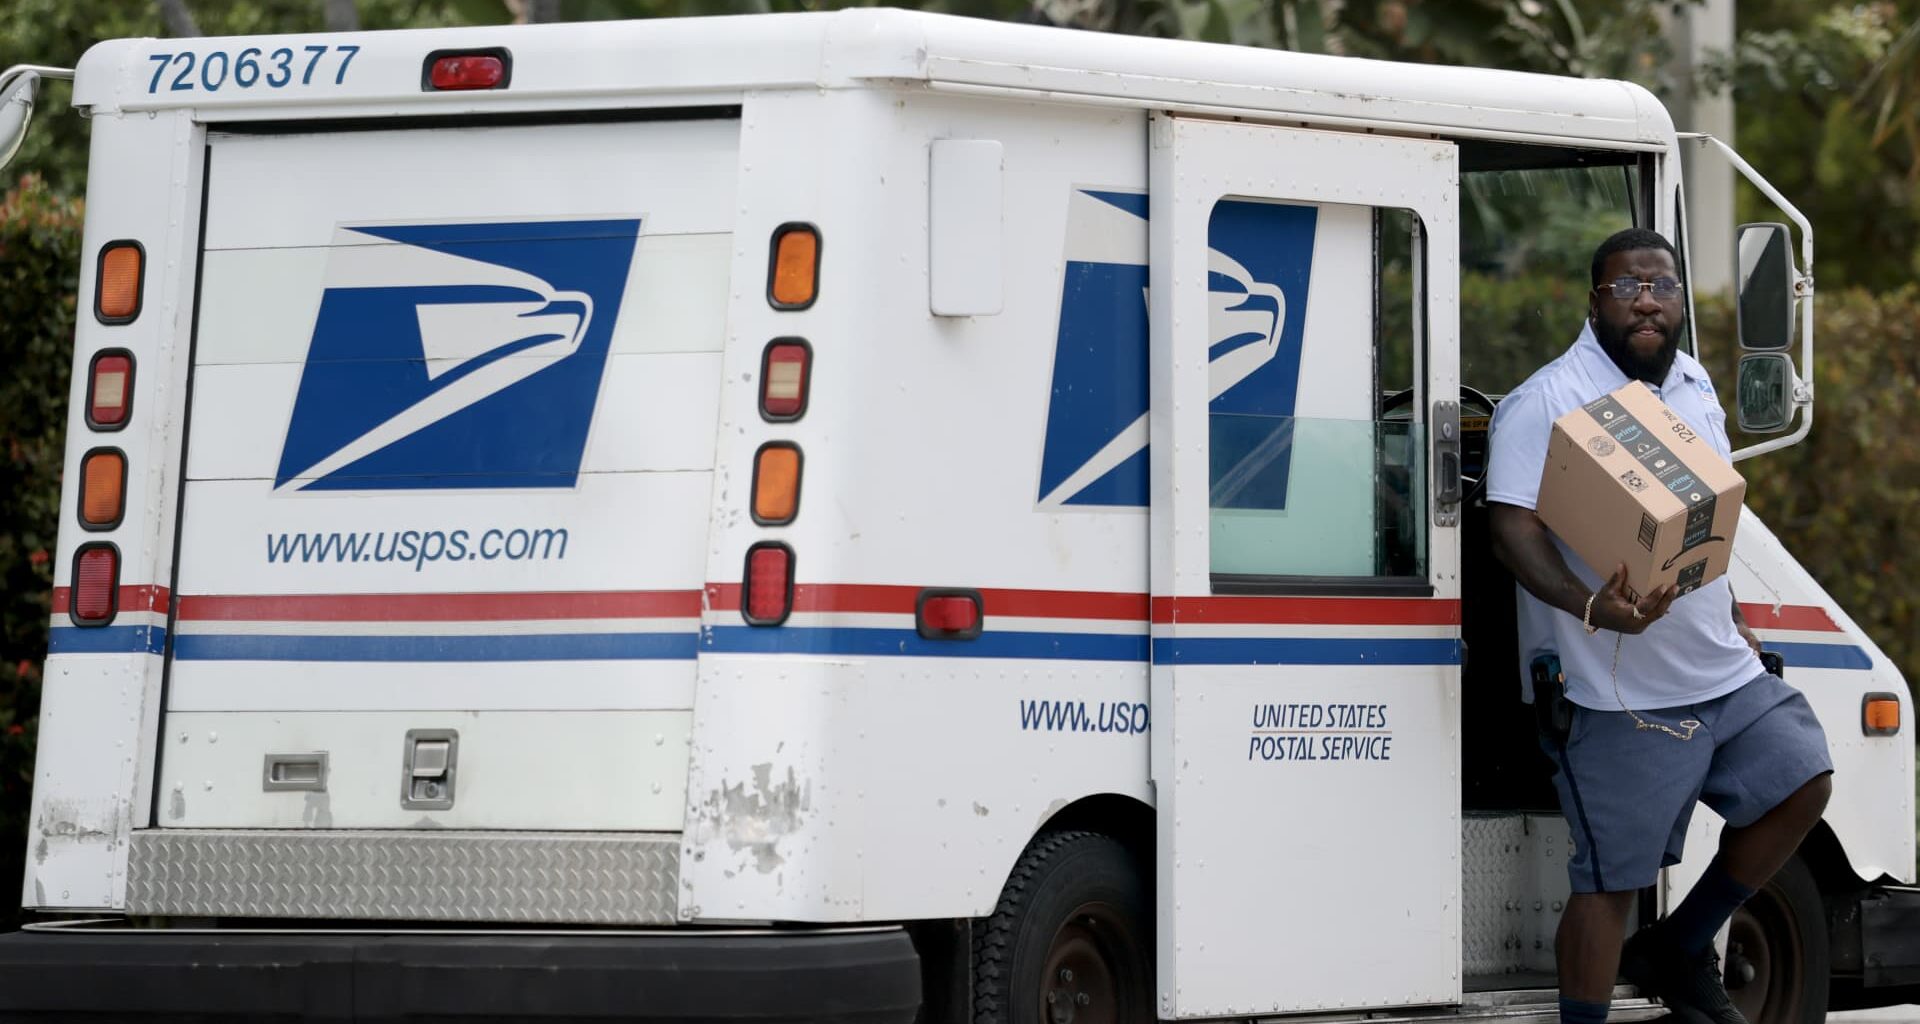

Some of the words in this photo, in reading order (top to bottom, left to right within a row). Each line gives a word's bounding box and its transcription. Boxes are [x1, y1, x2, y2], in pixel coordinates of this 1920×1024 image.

[148, 44, 360, 93] 7206377
[1672, 422, 1697, 444] 128
[1668, 473, 1692, 491] prime
[266, 526, 569, 571] www.usps.com
[1021, 700, 1151, 736] www.usp
[1253, 704, 1323, 728] UNITED
[1325, 704, 1387, 728] STATES
[1248, 736, 1317, 761] POSTAL
[1320, 736, 1392, 761] SERVICE
